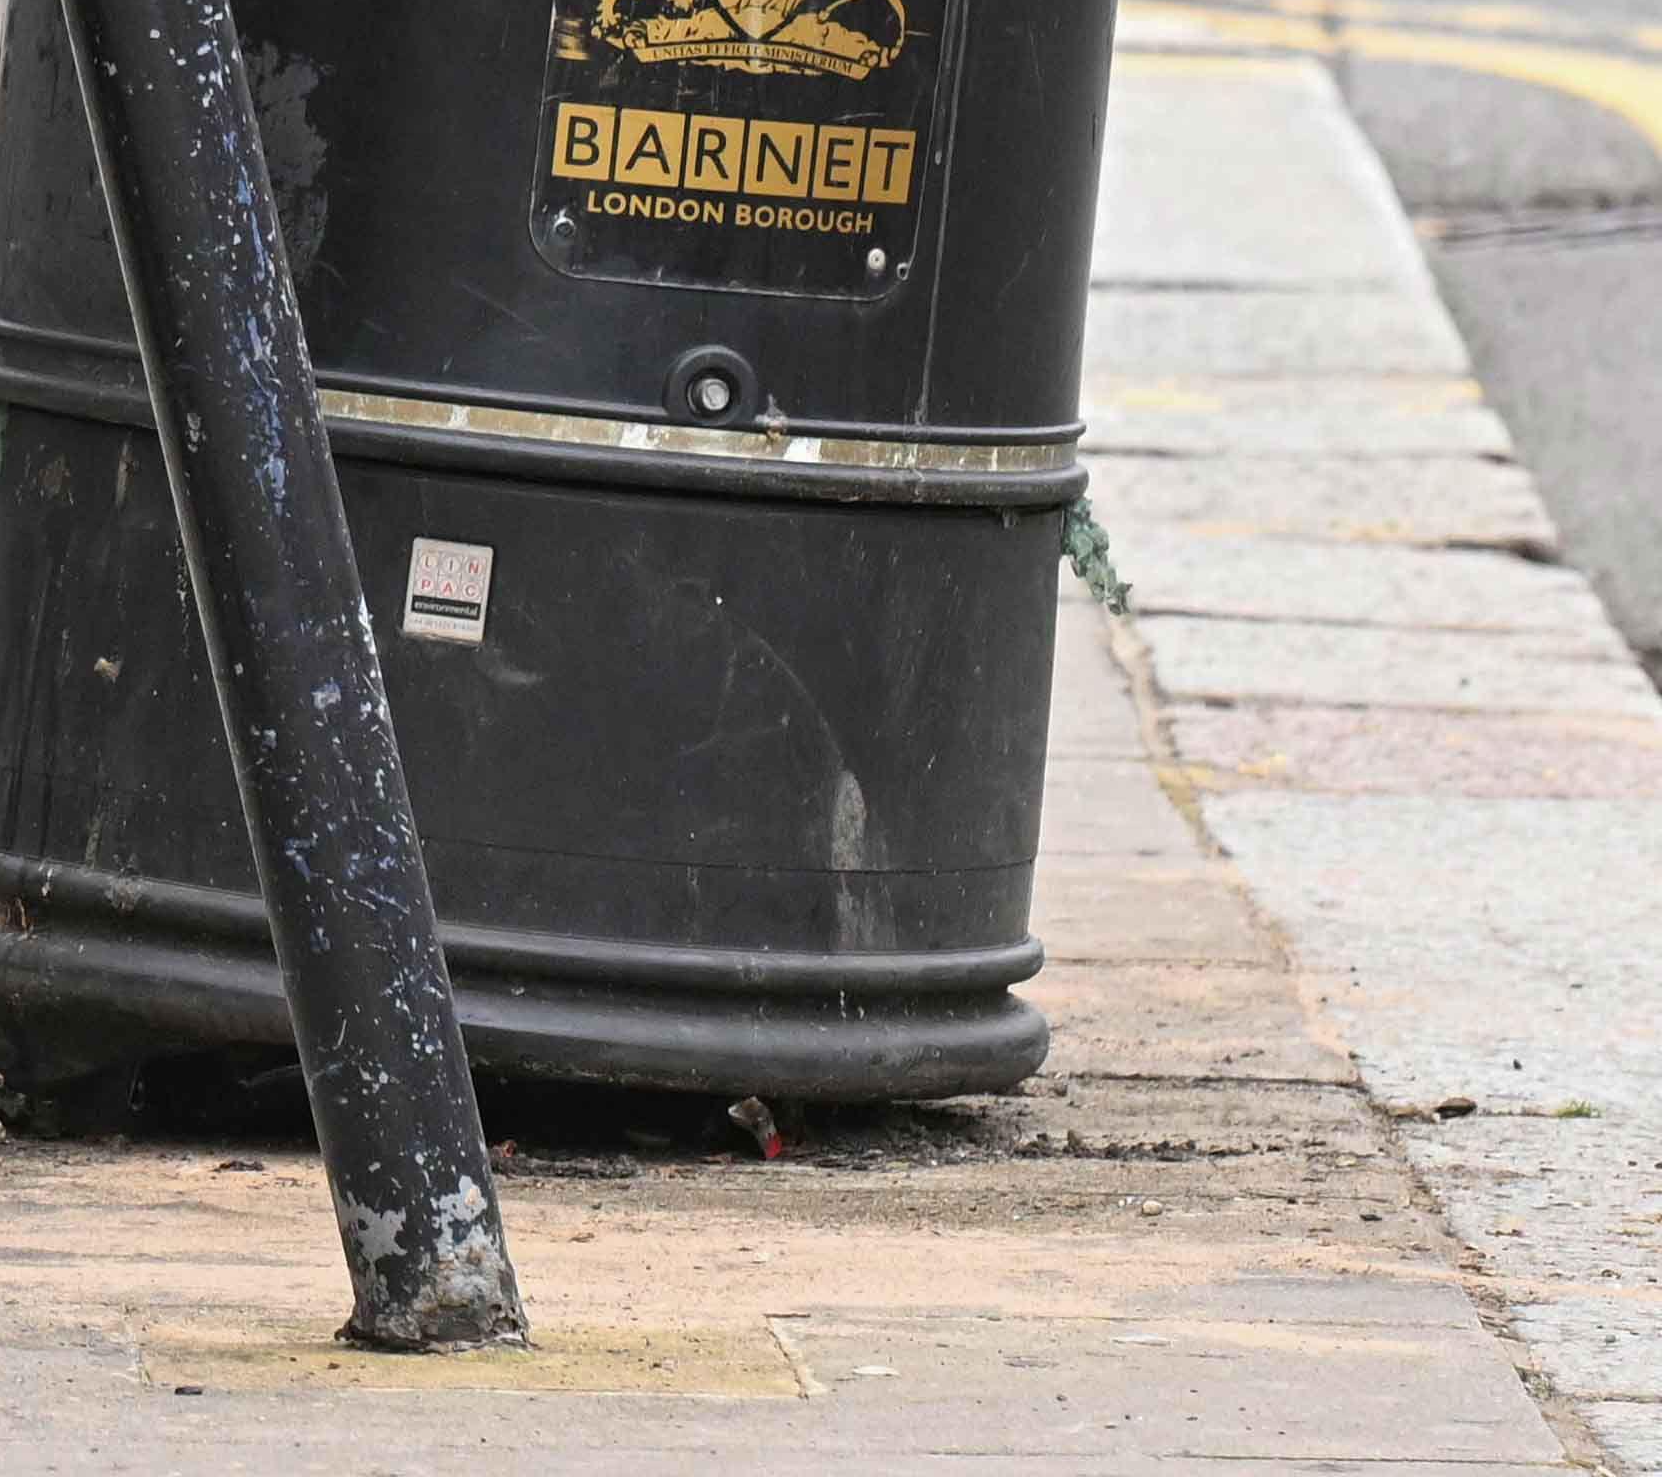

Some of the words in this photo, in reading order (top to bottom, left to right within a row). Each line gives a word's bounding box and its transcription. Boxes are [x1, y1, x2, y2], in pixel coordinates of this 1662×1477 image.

[652, 45, 702, 60] UNITAS
[563, 115, 910, 192] BARNET
[586, 189, 725, 225] LONDON
[734, 202, 874, 234] BOROUGH
[424, 555, 481, 574] LIN
[421, 580, 476, 597] PAC
[414, 600, 479, 617] environmental
